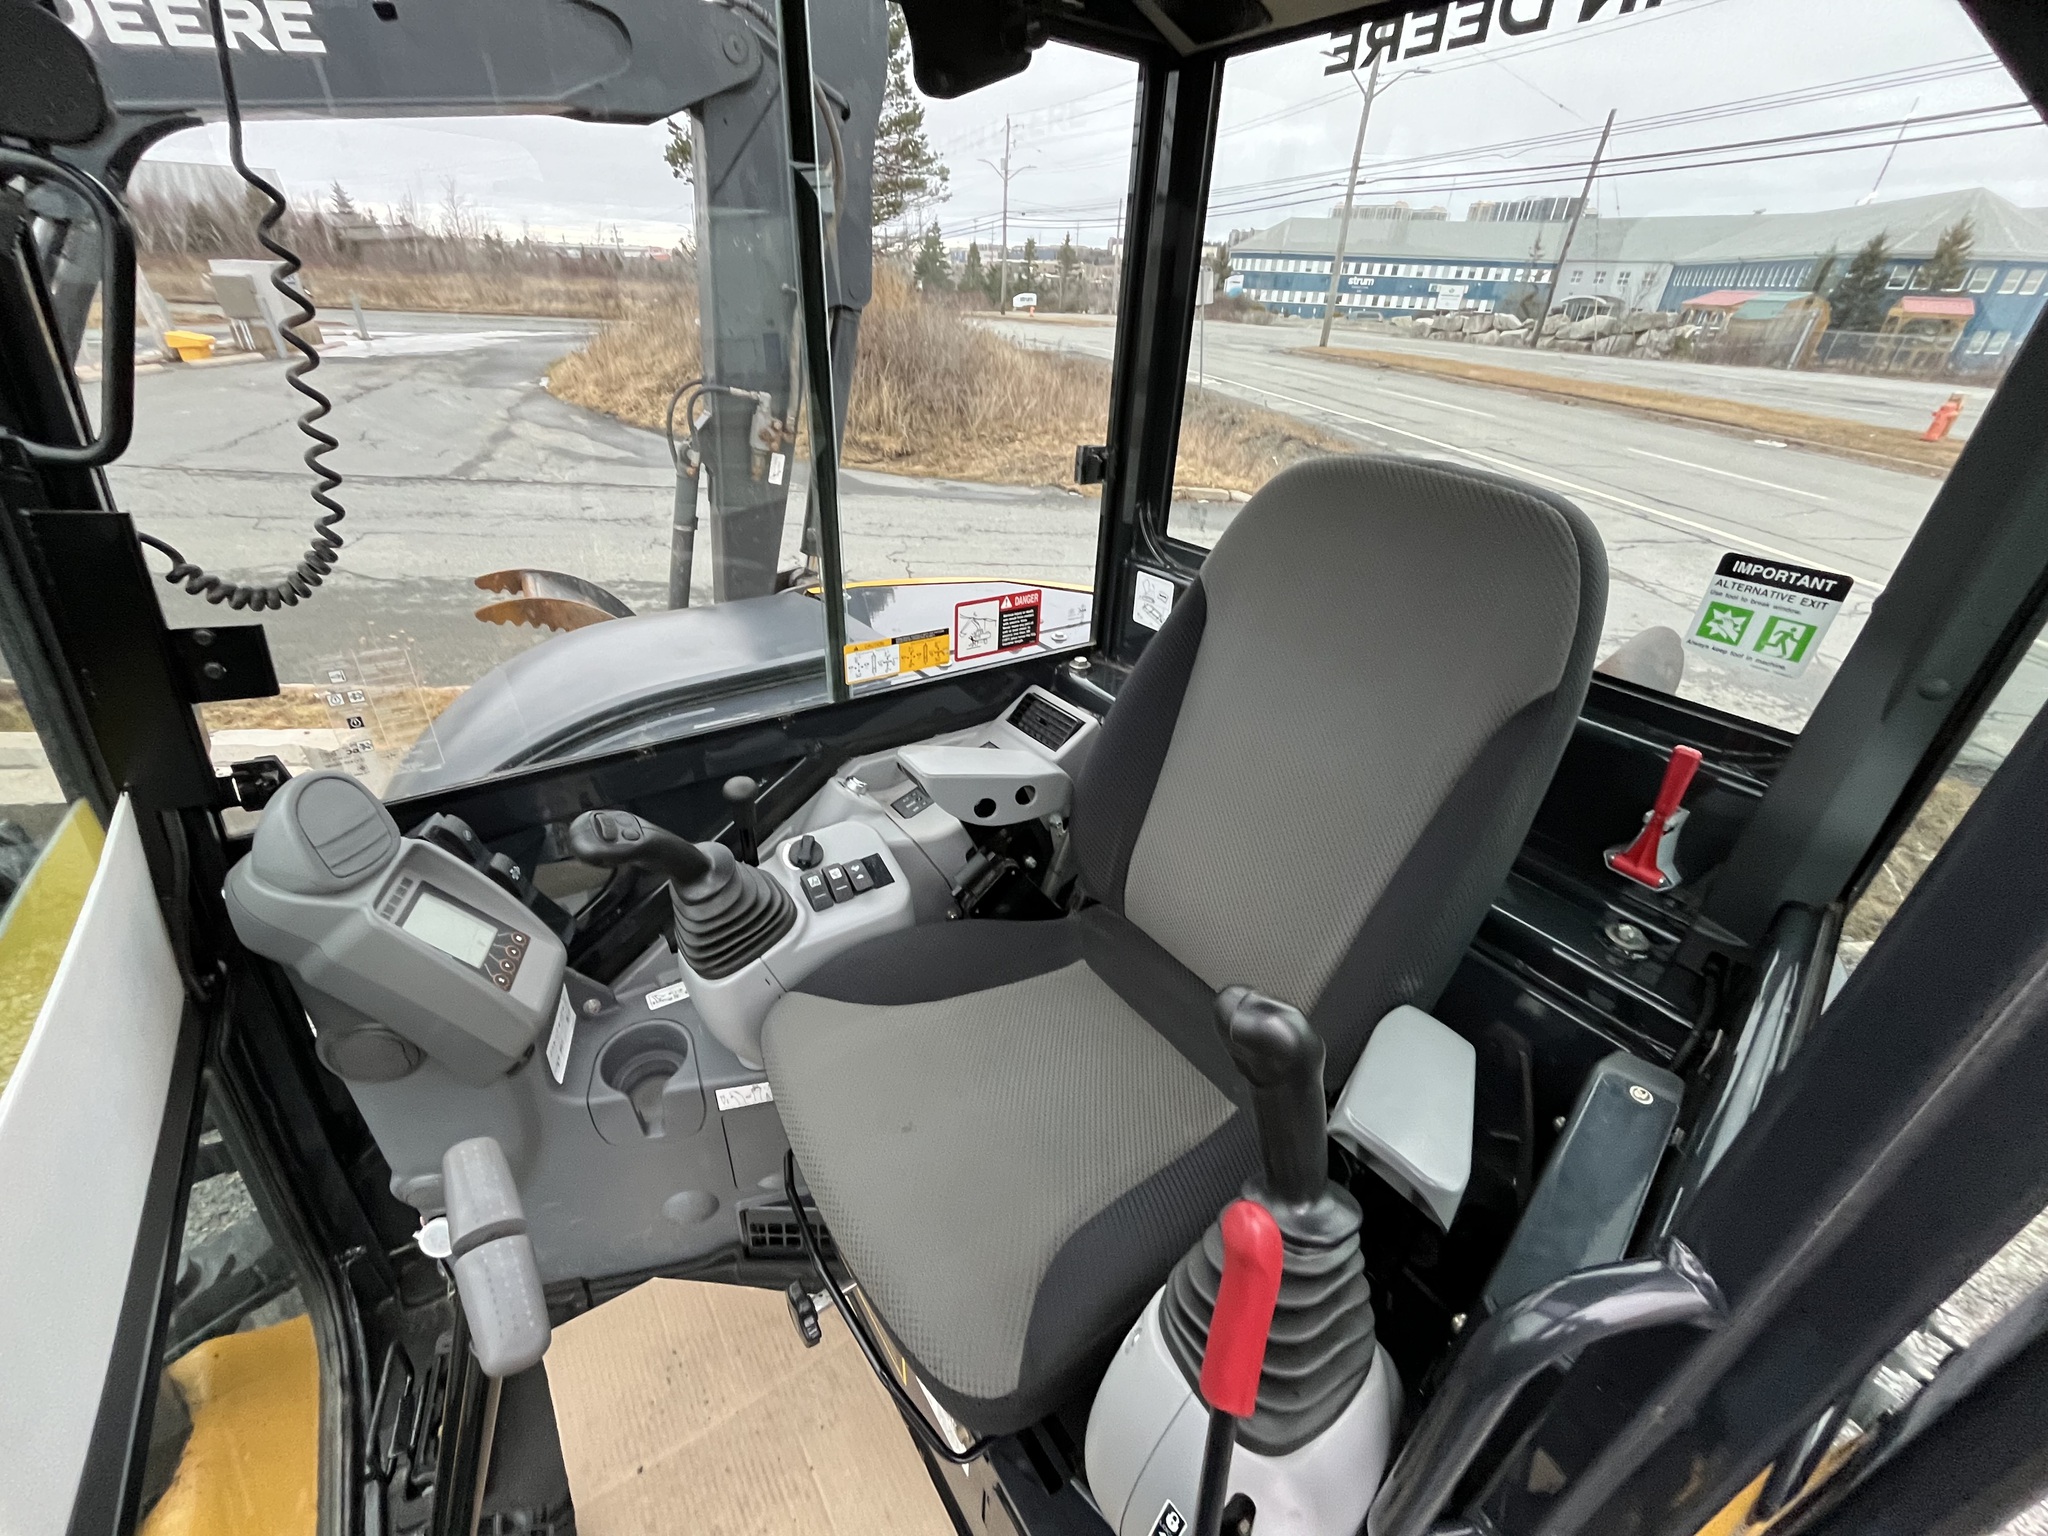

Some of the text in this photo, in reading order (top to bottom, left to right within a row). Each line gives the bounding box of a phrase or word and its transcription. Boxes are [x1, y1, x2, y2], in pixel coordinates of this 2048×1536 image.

[1348, 276, 1375, 286] strum
[1732, 560, 1838, 593] IMPORTANT
[1014, 593, 1039, 606] DANGER
[1710, 589, 1723, 597] Use
[1725, 593, 1739, 601] tool
[1750, 599, 1770, 608] break
[1714, 578, 1830, 611] ALTERNATIVE EXIT
[1712, 646, 1728, 655] keep
